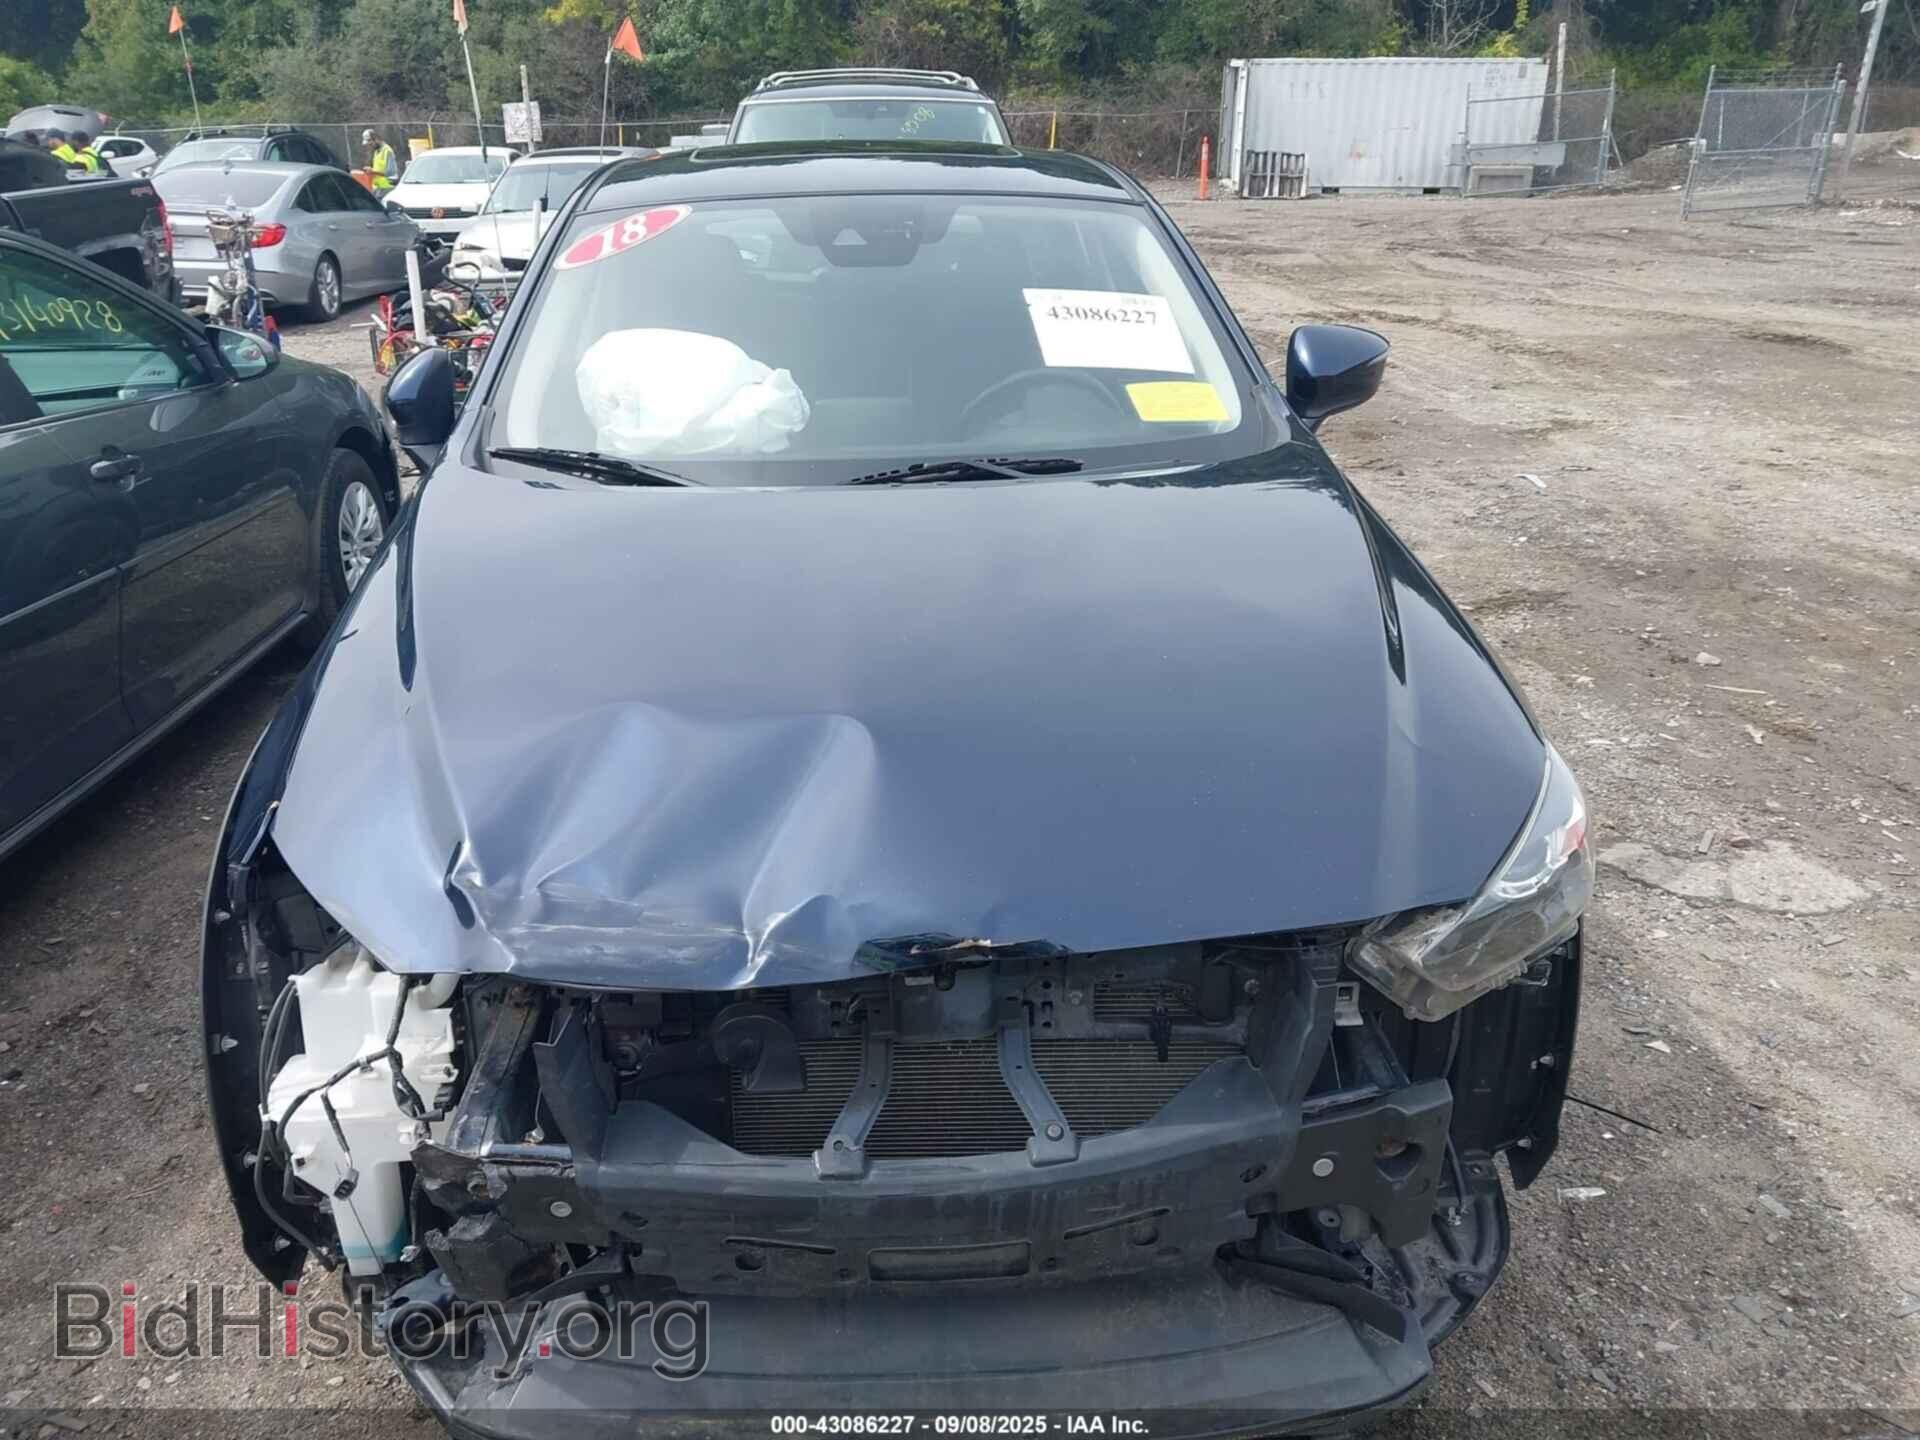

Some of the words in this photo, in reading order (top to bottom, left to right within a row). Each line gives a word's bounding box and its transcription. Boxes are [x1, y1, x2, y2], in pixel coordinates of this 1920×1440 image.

[597, 213, 648, 256] 18
[0, 294, 122, 341] 3140928
[1047, 304, 1157, 325] 43086227
